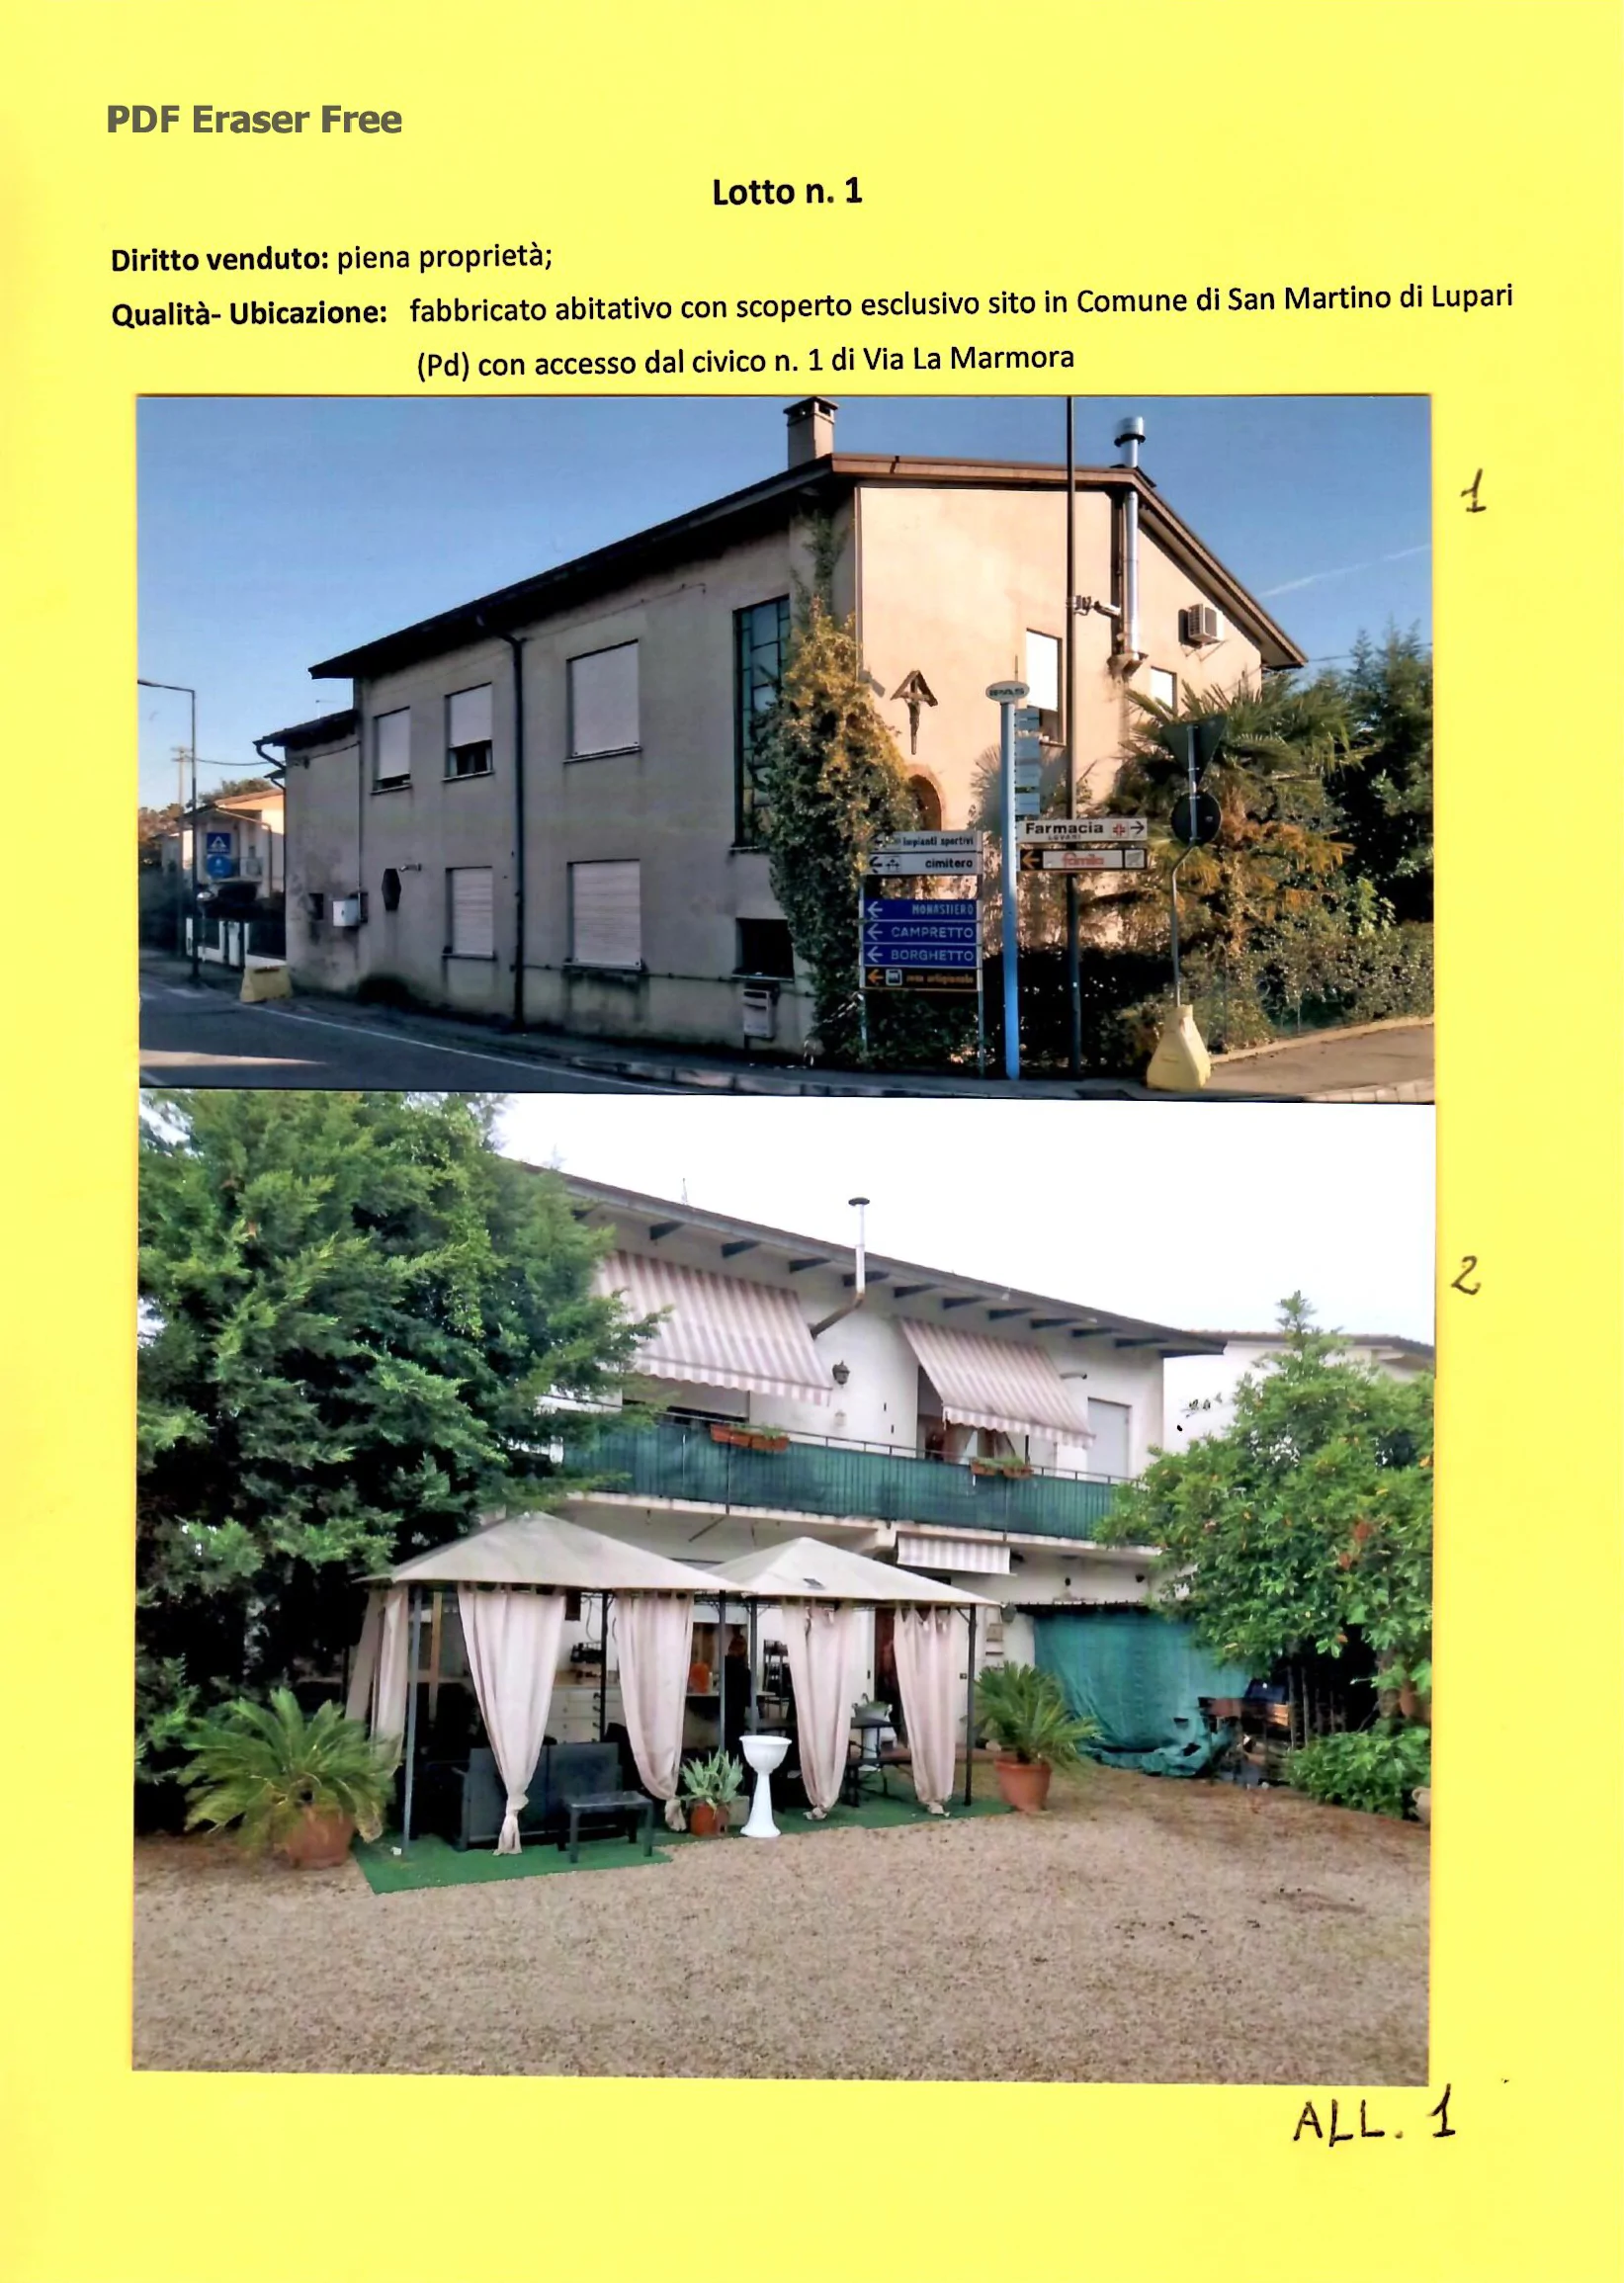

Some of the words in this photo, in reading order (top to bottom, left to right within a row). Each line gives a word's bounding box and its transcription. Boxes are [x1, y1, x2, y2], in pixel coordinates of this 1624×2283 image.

[713, 179, 795, 206] Lotto
[807, 184, 834, 205] n.
[846, 177, 863, 204] 1
[113, 248, 199, 272] Diritto
[207, 246, 327, 271] venduto:
[339, 245, 410, 276] piena
[420, 241, 552, 274] proprietà;
[113, 300, 220, 329] Qualità-
[230, 300, 386, 325] Ubicazione:
[410, 298, 546, 323] fabbricato
[556, 296, 671, 321] abitativo
[681, 301, 727, 319] con
[737, 296, 851, 324] scoperto
[862, 292, 979, 316] esclusivo
[989, 291, 1035, 314] sito
[1046, 291, 1067, 313] in
[1077, 290, 1187, 313] Comune
[1197, 288, 1219, 312] di
[1229, 288, 1274, 311] San
[1286, 286, 1391, 310] Martino
[1401, 284, 1421, 308] di
[1433, 283, 1513, 312] Lupari
[418, 351, 469, 382] (Pd)
[478, 359, 525, 377] con
[536, 357, 636, 376] accesso
[645, 349, 683, 375] dal
[693, 349, 765, 374] civico
[776, 355, 799, 373] n.
[810, 348, 823, 372] 1
[832, 347, 854, 372] di
[863, 347, 903, 371] Via
[914, 346, 941, 371] La
[952, 347, 1074, 370] Marmora
[1460, 467, 1487, 513] 1
[940, 836, 974, 847] sportivi
[1025, 822, 1103, 834] Farmacia
[925, 858, 973, 868] cimitero
[912, 903, 975, 915] MONASTIERO
[891, 926, 975, 938] CAMPRETTO
[891, 949, 975, 961] BORGHETTO
[1450, 1255, 1481, 1296] 2
[1293, 2098, 1404, 2147] ALL.
[1427, 2083, 1456, 2138] 1
